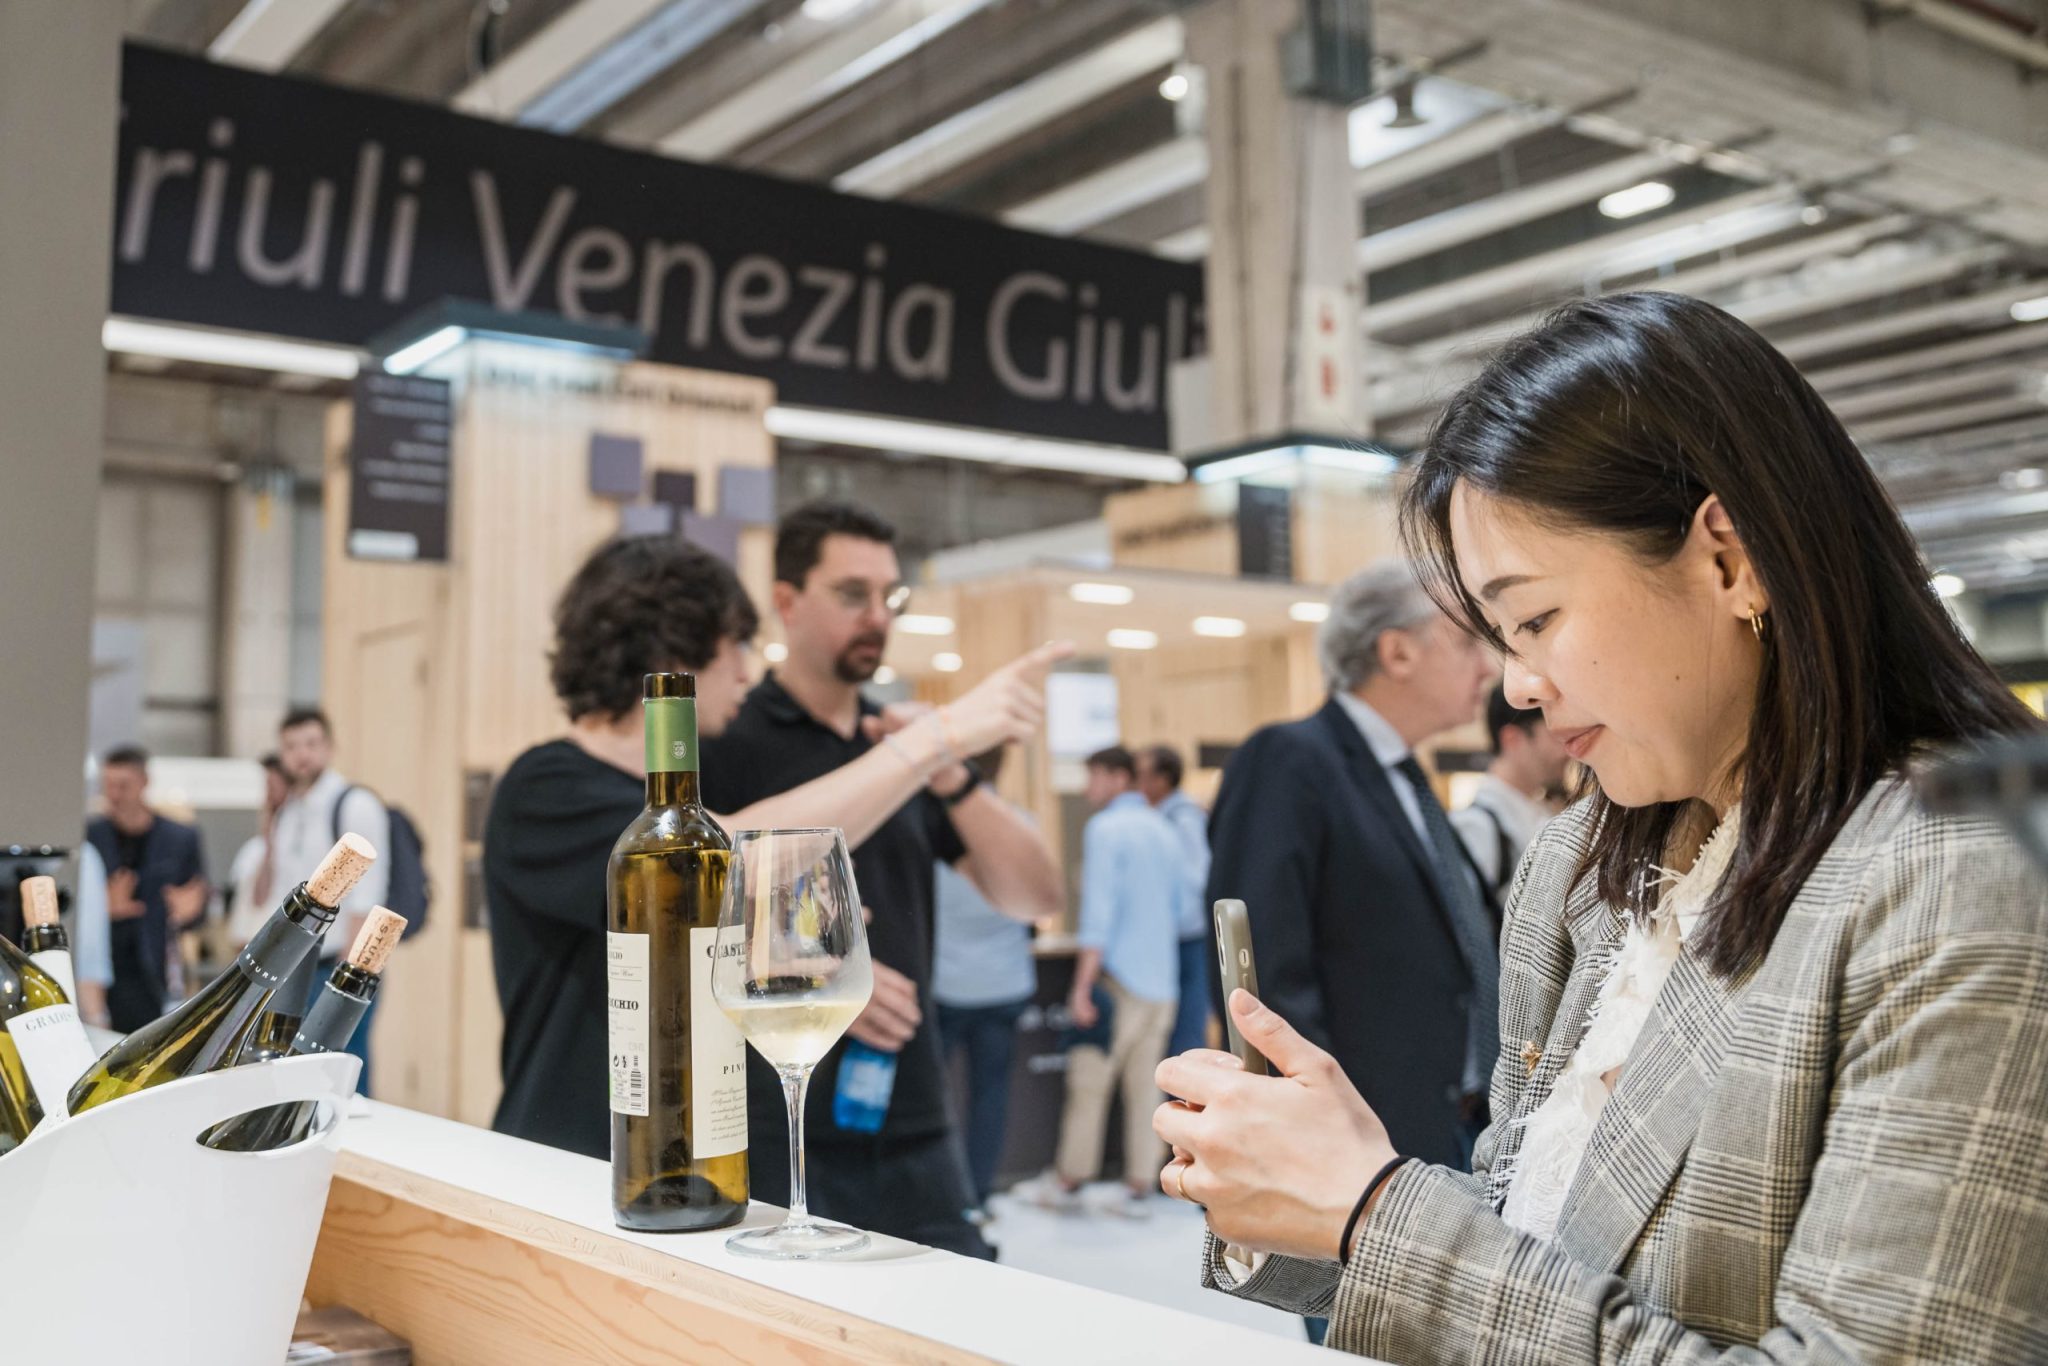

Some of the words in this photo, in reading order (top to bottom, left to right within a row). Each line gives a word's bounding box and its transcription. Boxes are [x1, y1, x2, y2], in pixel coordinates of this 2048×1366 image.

[118, 101, 426, 302] riuli
[470, 168, 954, 382] Venezia
[245, 952, 279, 982] STURM
